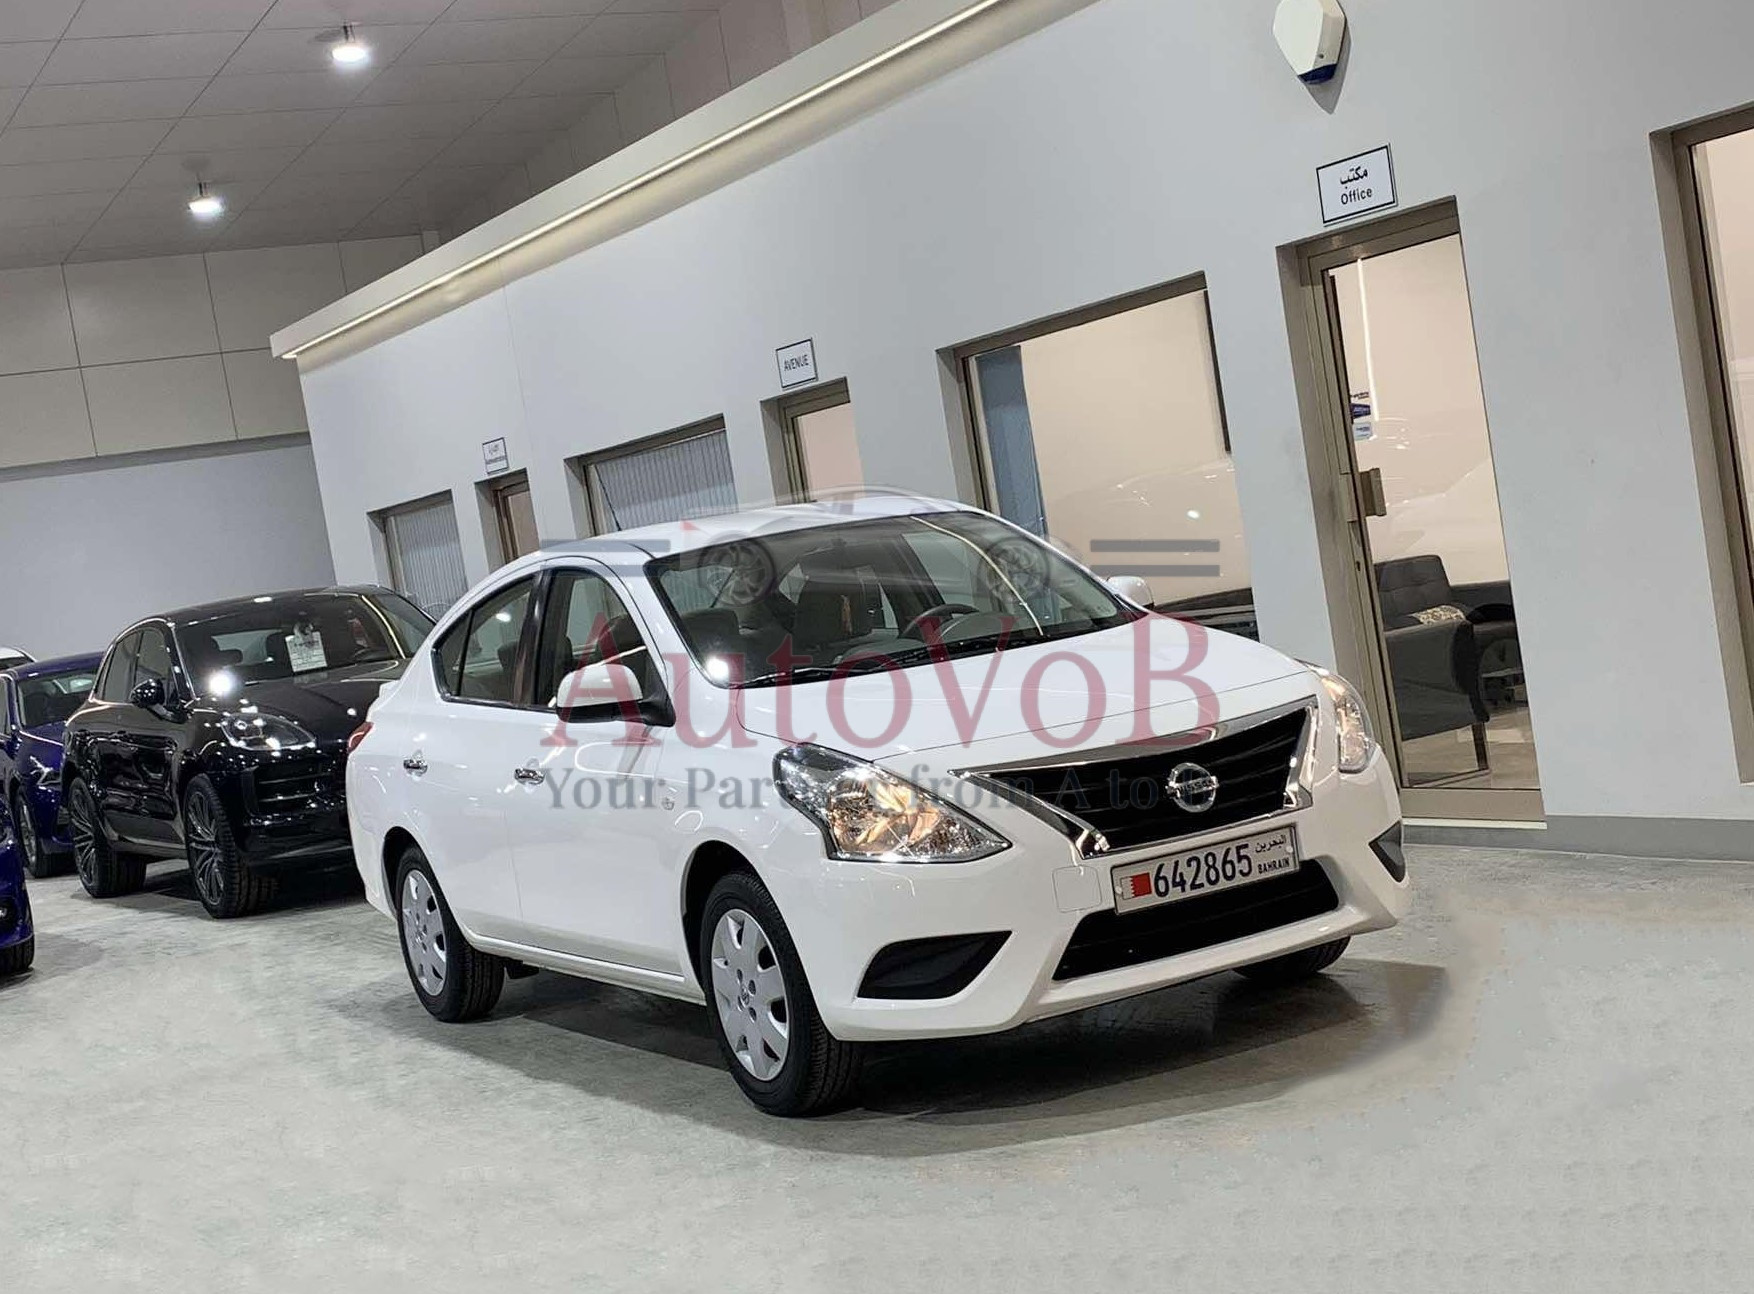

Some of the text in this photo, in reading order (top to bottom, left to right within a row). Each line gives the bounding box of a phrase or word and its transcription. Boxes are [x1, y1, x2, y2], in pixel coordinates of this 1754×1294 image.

[1340, 166, 1368, 189] مكتب
[1340, 188, 1373, 205] Office
[1255, 834, 1287, 853] البحرين
[1154, 843, 1252, 898] 642865
[1257, 857, 1290, 874] BAHRAIN
